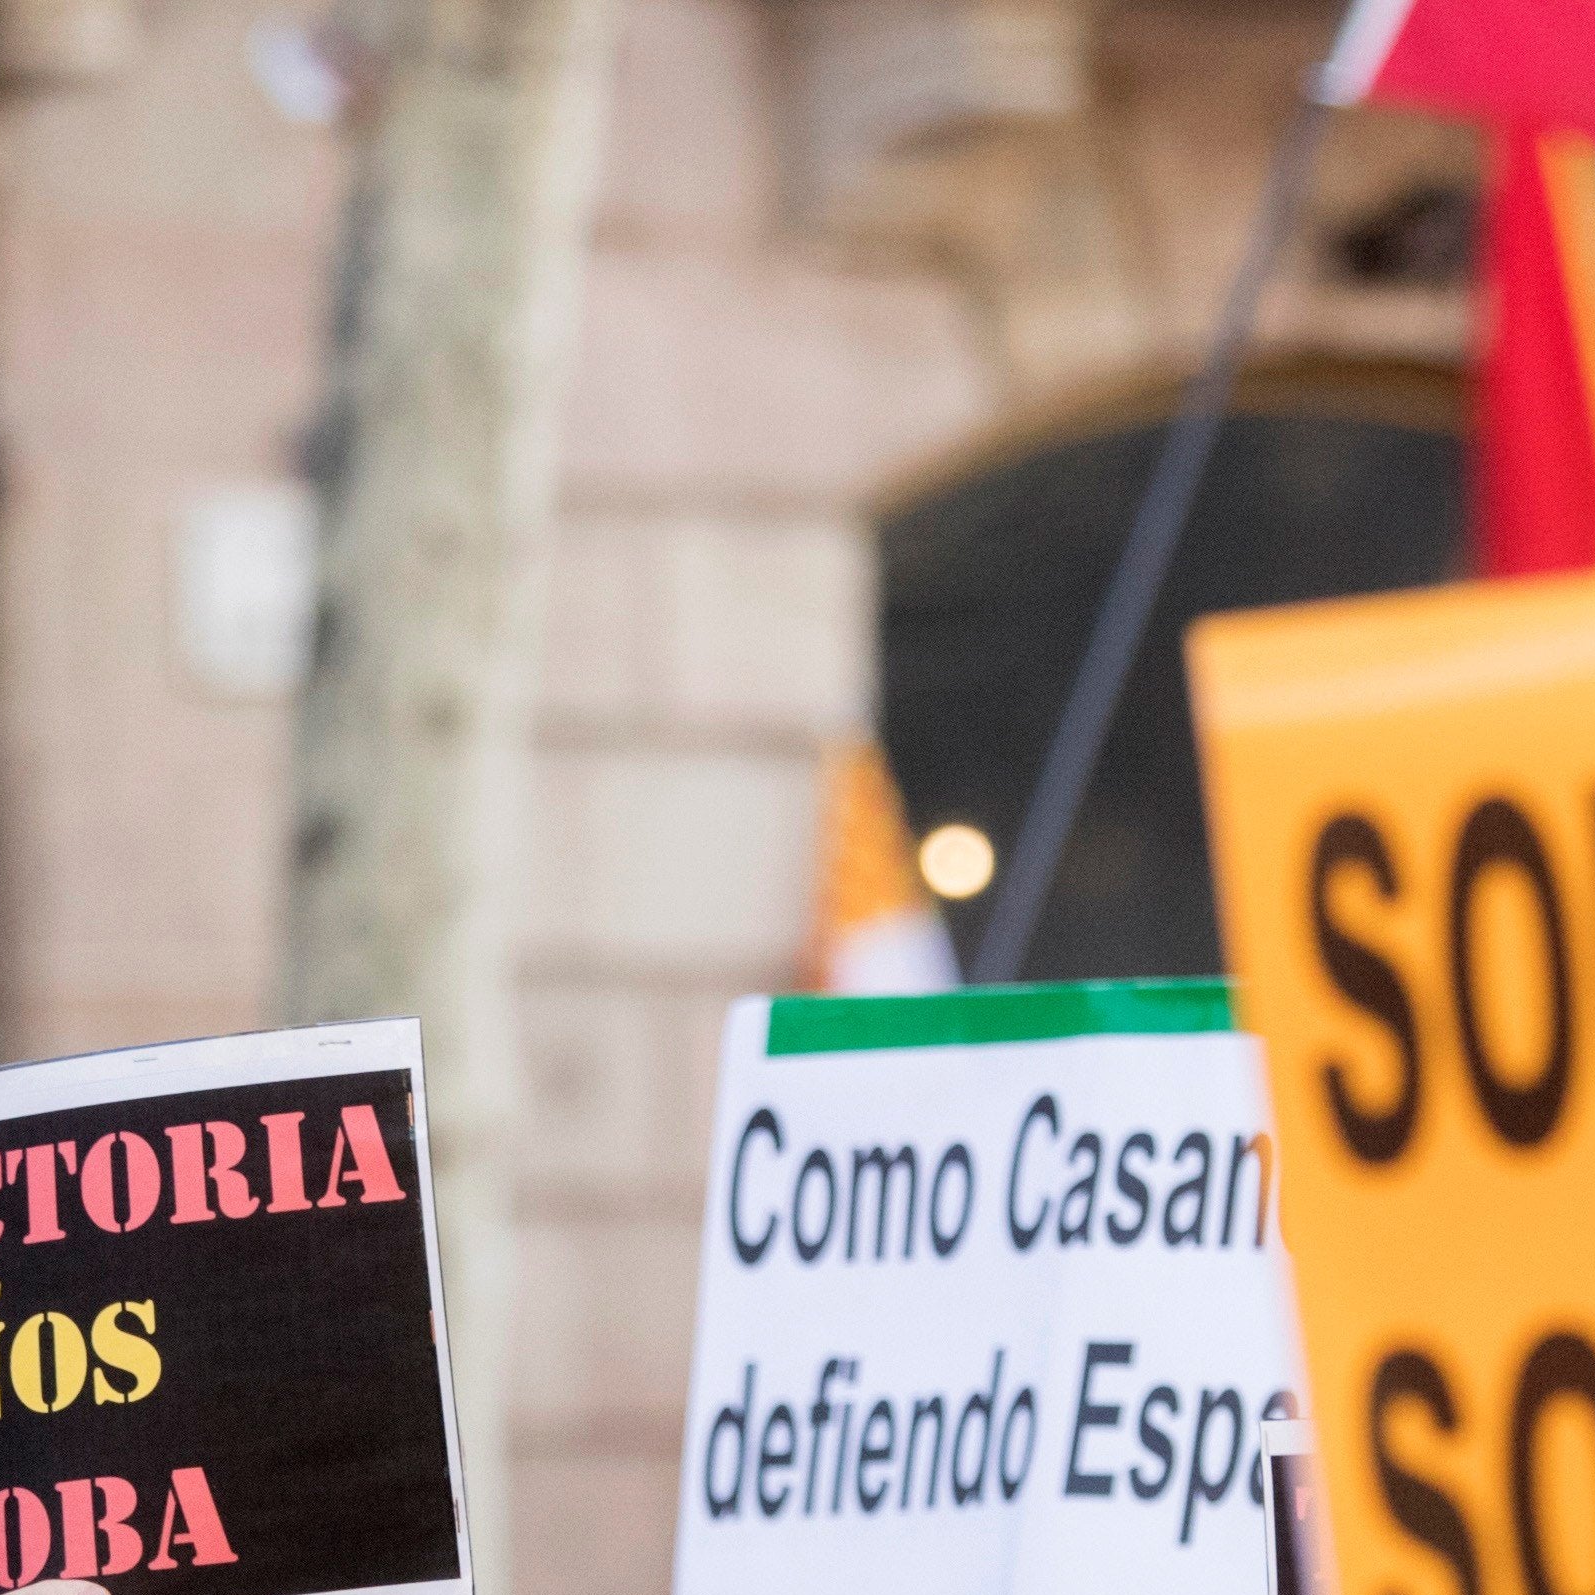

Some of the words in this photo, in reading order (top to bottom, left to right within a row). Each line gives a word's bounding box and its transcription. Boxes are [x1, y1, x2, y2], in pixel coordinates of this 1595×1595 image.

[729, 1107, 975, 1265] Como
[1004, 1093, 1273, 1253] Casan
[705, 1349, 1036, 1522] defiendo
